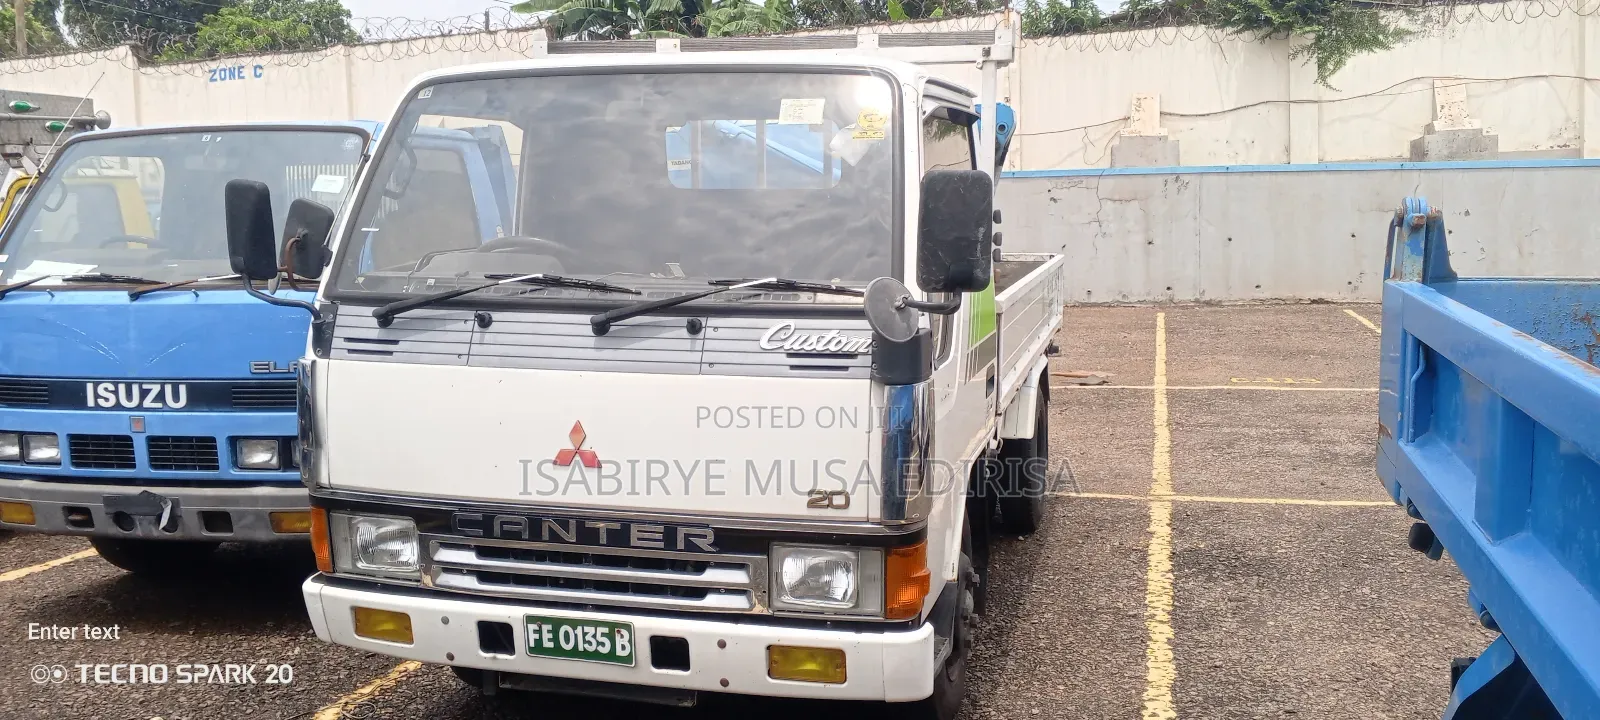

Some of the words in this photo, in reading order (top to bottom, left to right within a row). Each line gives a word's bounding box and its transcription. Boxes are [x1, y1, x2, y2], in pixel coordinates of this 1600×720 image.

[209, 65, 245, 82] ZONE
[253, 64, 264, 78] C
[760, 320, 872, 352] Custom
[86, 382, 187, 408] ISUZU
[807, 488, 850, 510] 20
[452, 512, 717, 551] CANTER
[527, 623, 554, 648] FE
[559, 624, 611, 654] 0135
[615, 628, 631, 656] B
